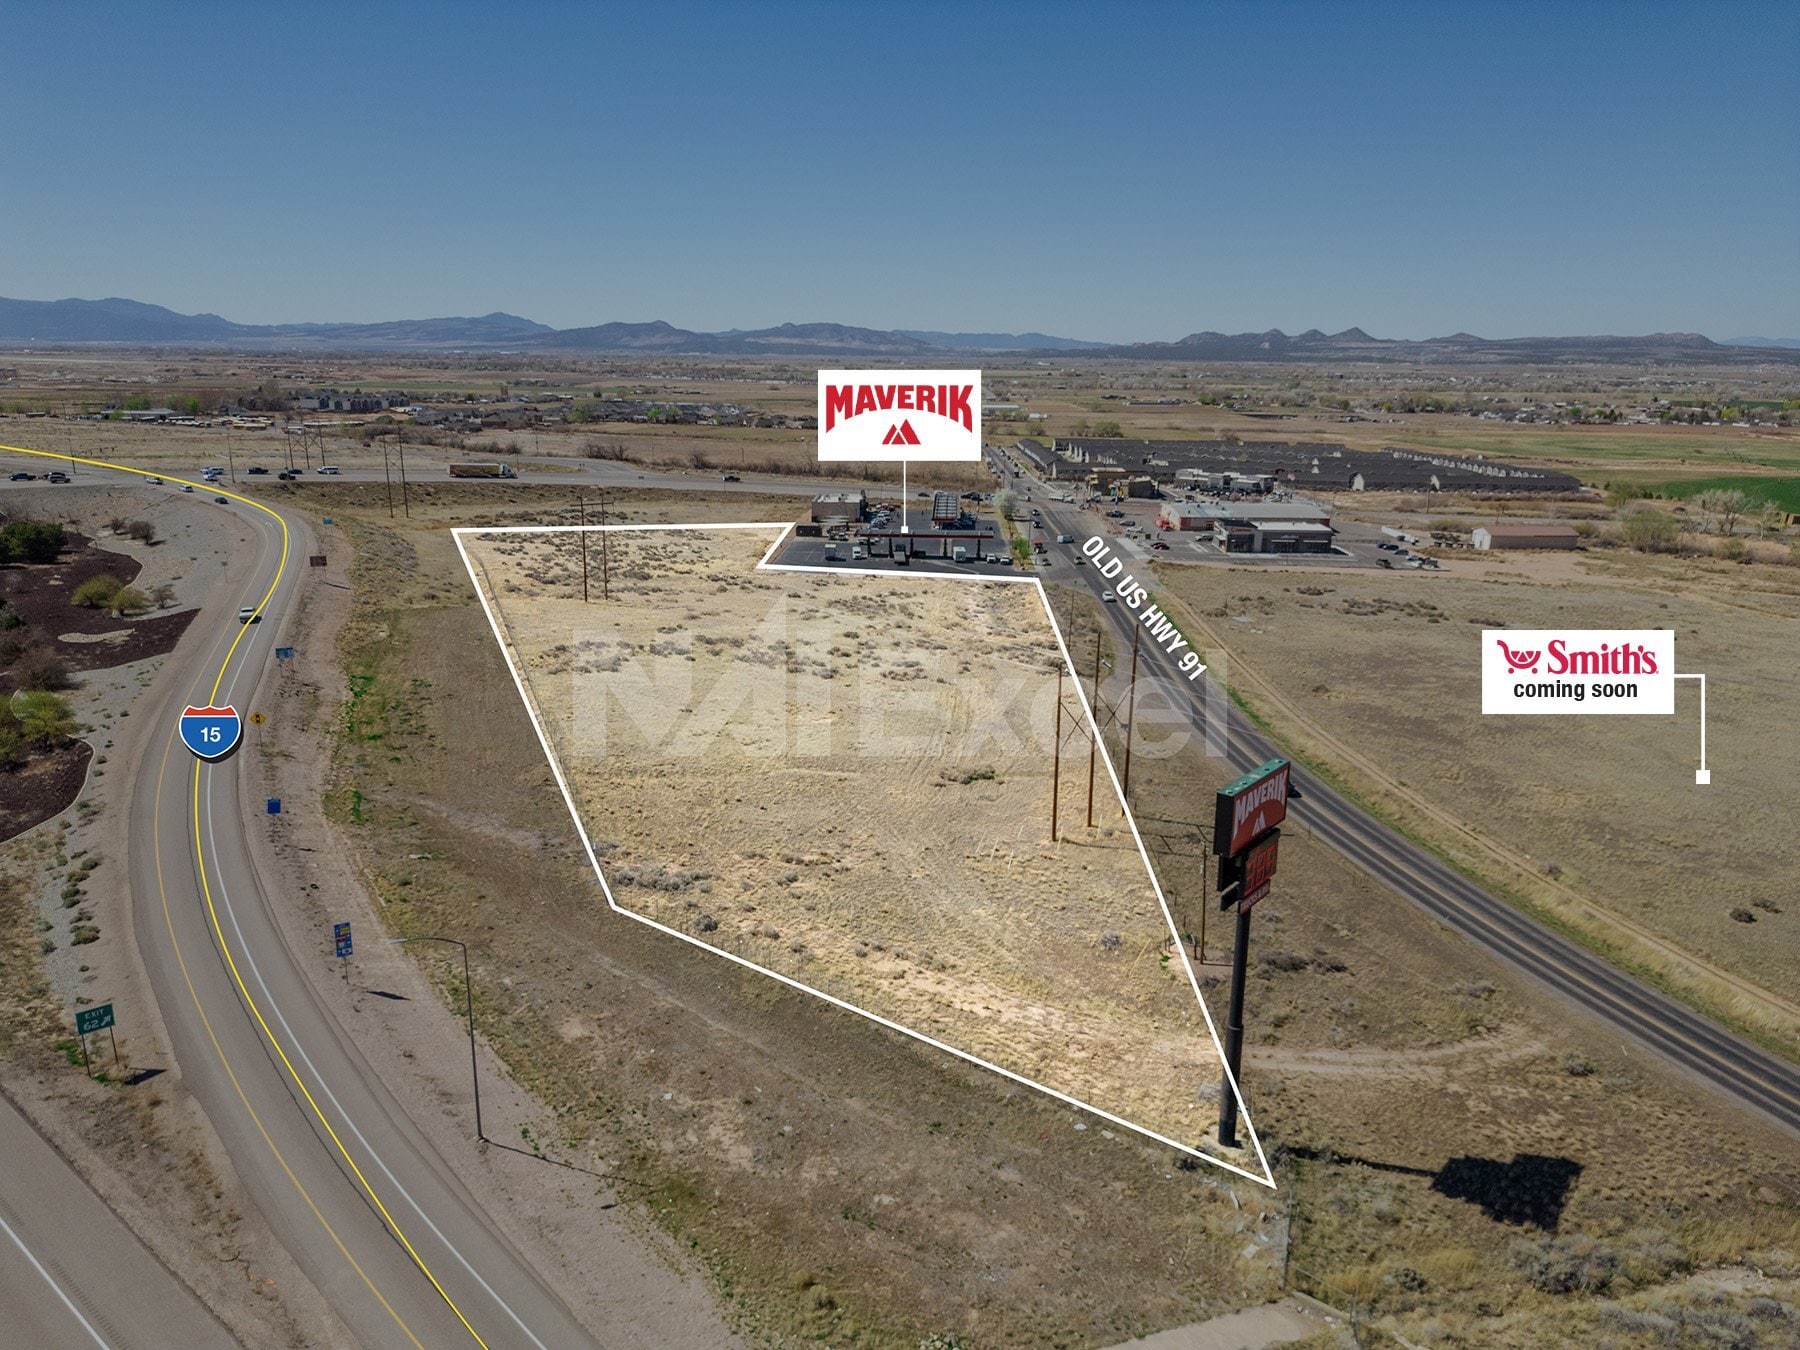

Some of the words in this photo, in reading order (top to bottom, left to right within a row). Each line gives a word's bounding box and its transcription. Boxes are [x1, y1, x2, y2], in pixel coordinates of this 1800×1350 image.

[1233, 769, 1288, 840] MAVERIK
[85, 1009, 104, 1019] EXIT
[83, 1020, 99, 1031] 62
